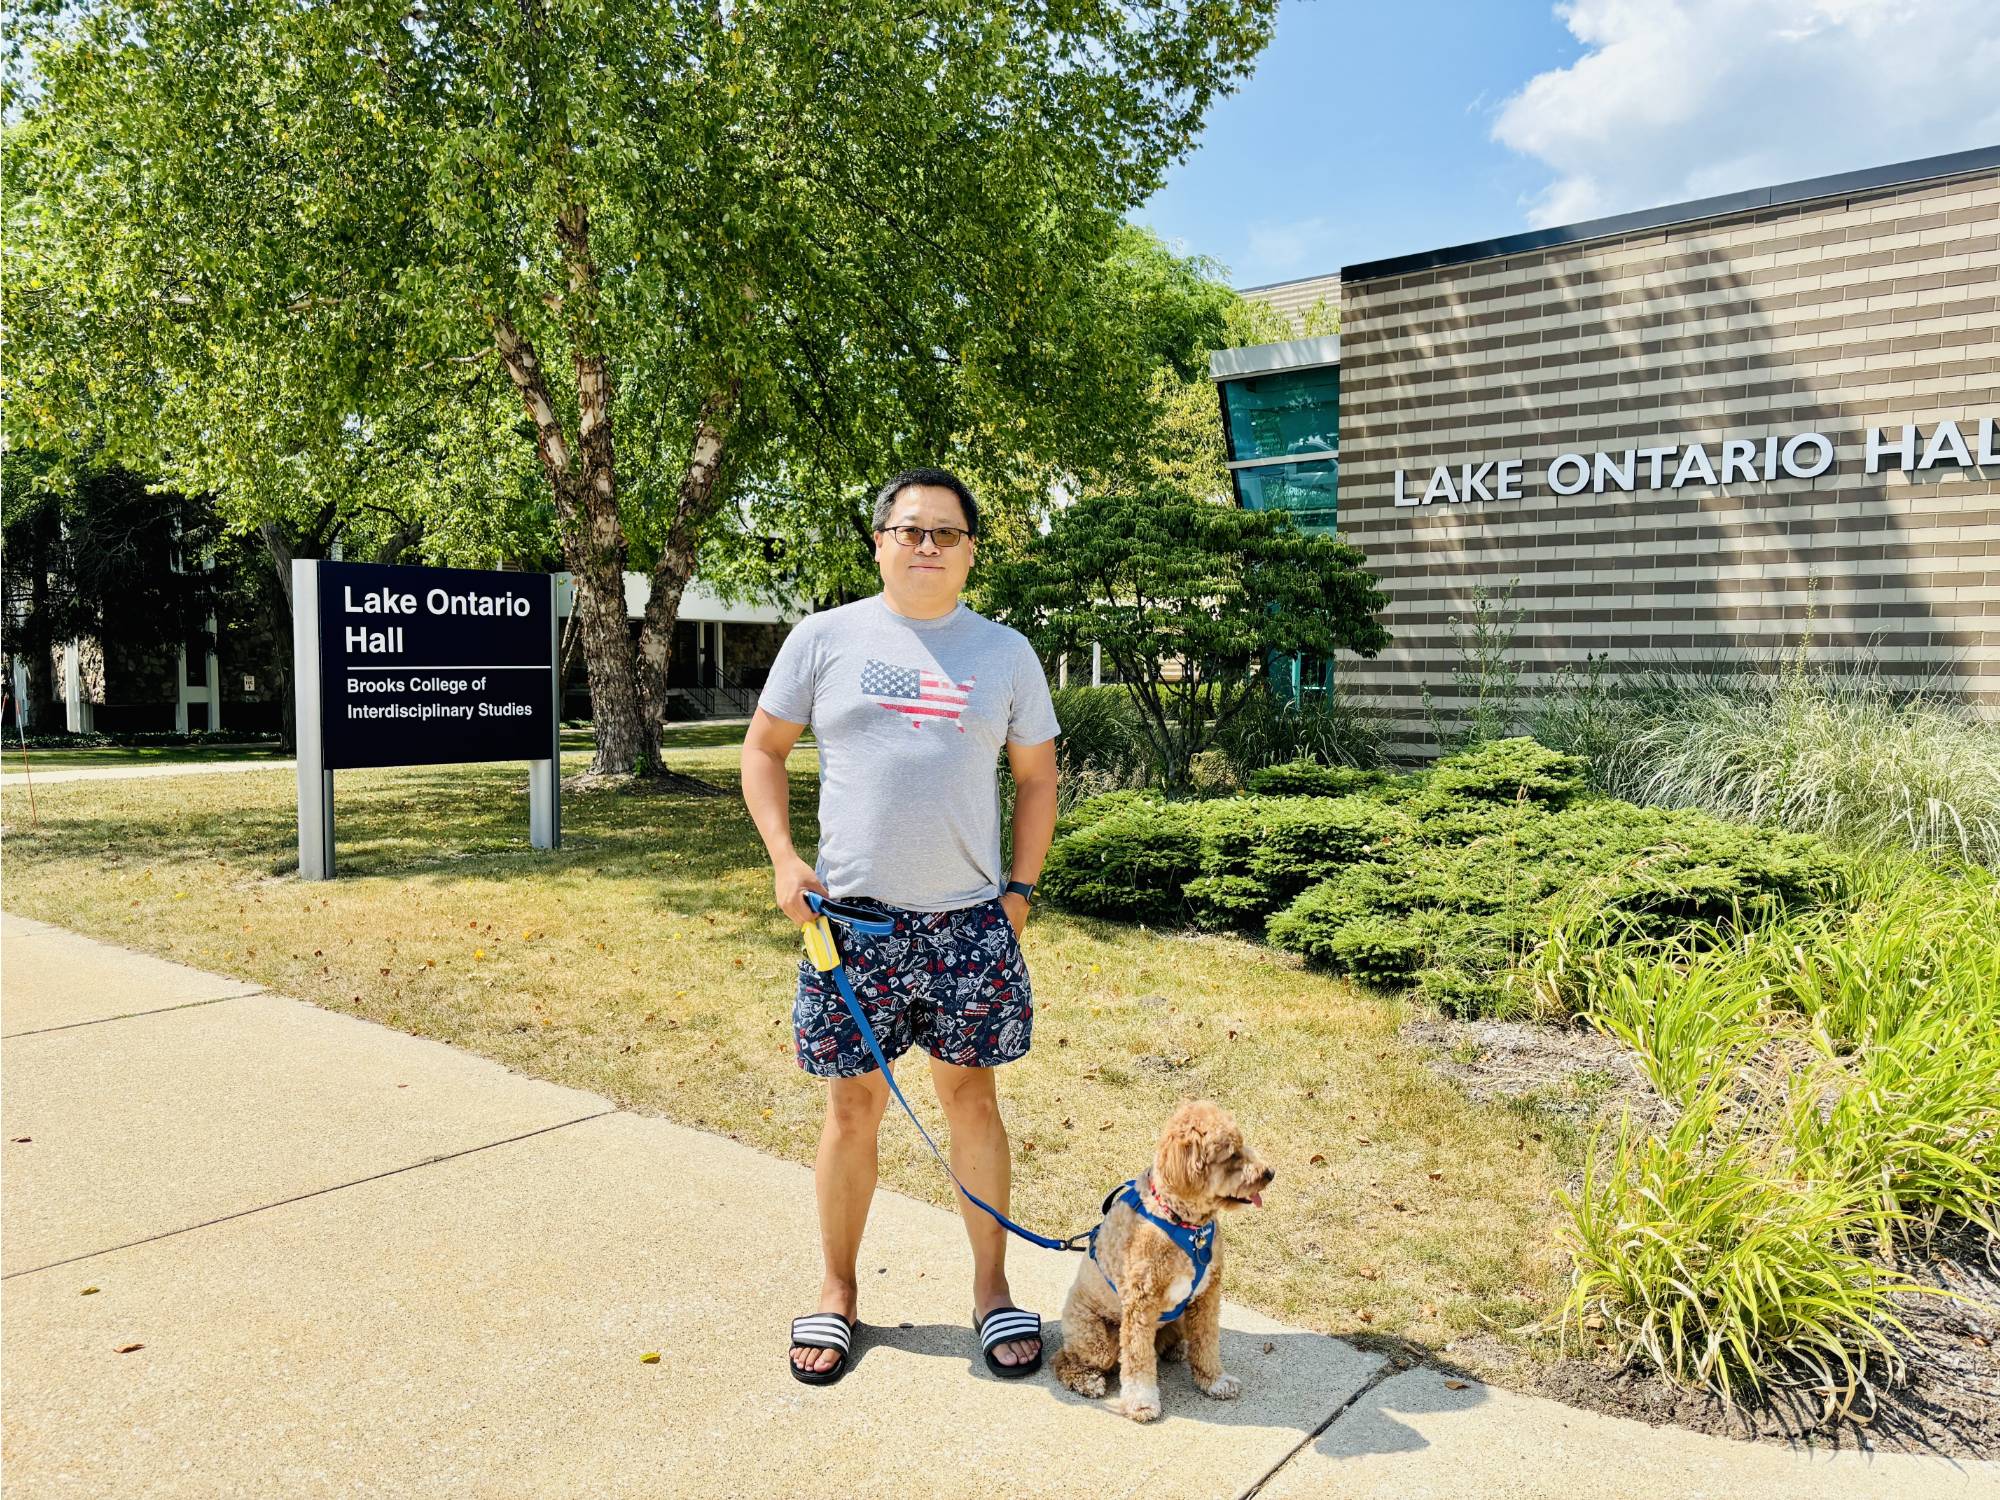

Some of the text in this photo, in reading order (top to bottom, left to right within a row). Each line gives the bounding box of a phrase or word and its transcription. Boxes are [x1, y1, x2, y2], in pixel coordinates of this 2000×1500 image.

[1394, 459, 1523, 507] LAKE
[1547, 432, 1834, 494] ONTARIO
[344, 586, 531, 617] Lake Ontario
[345, 626, 403, 653] Hall
[347, 676, 487, 694] Brooks College of
[347, 702, 533, 720] Interdisciplinary Studies
